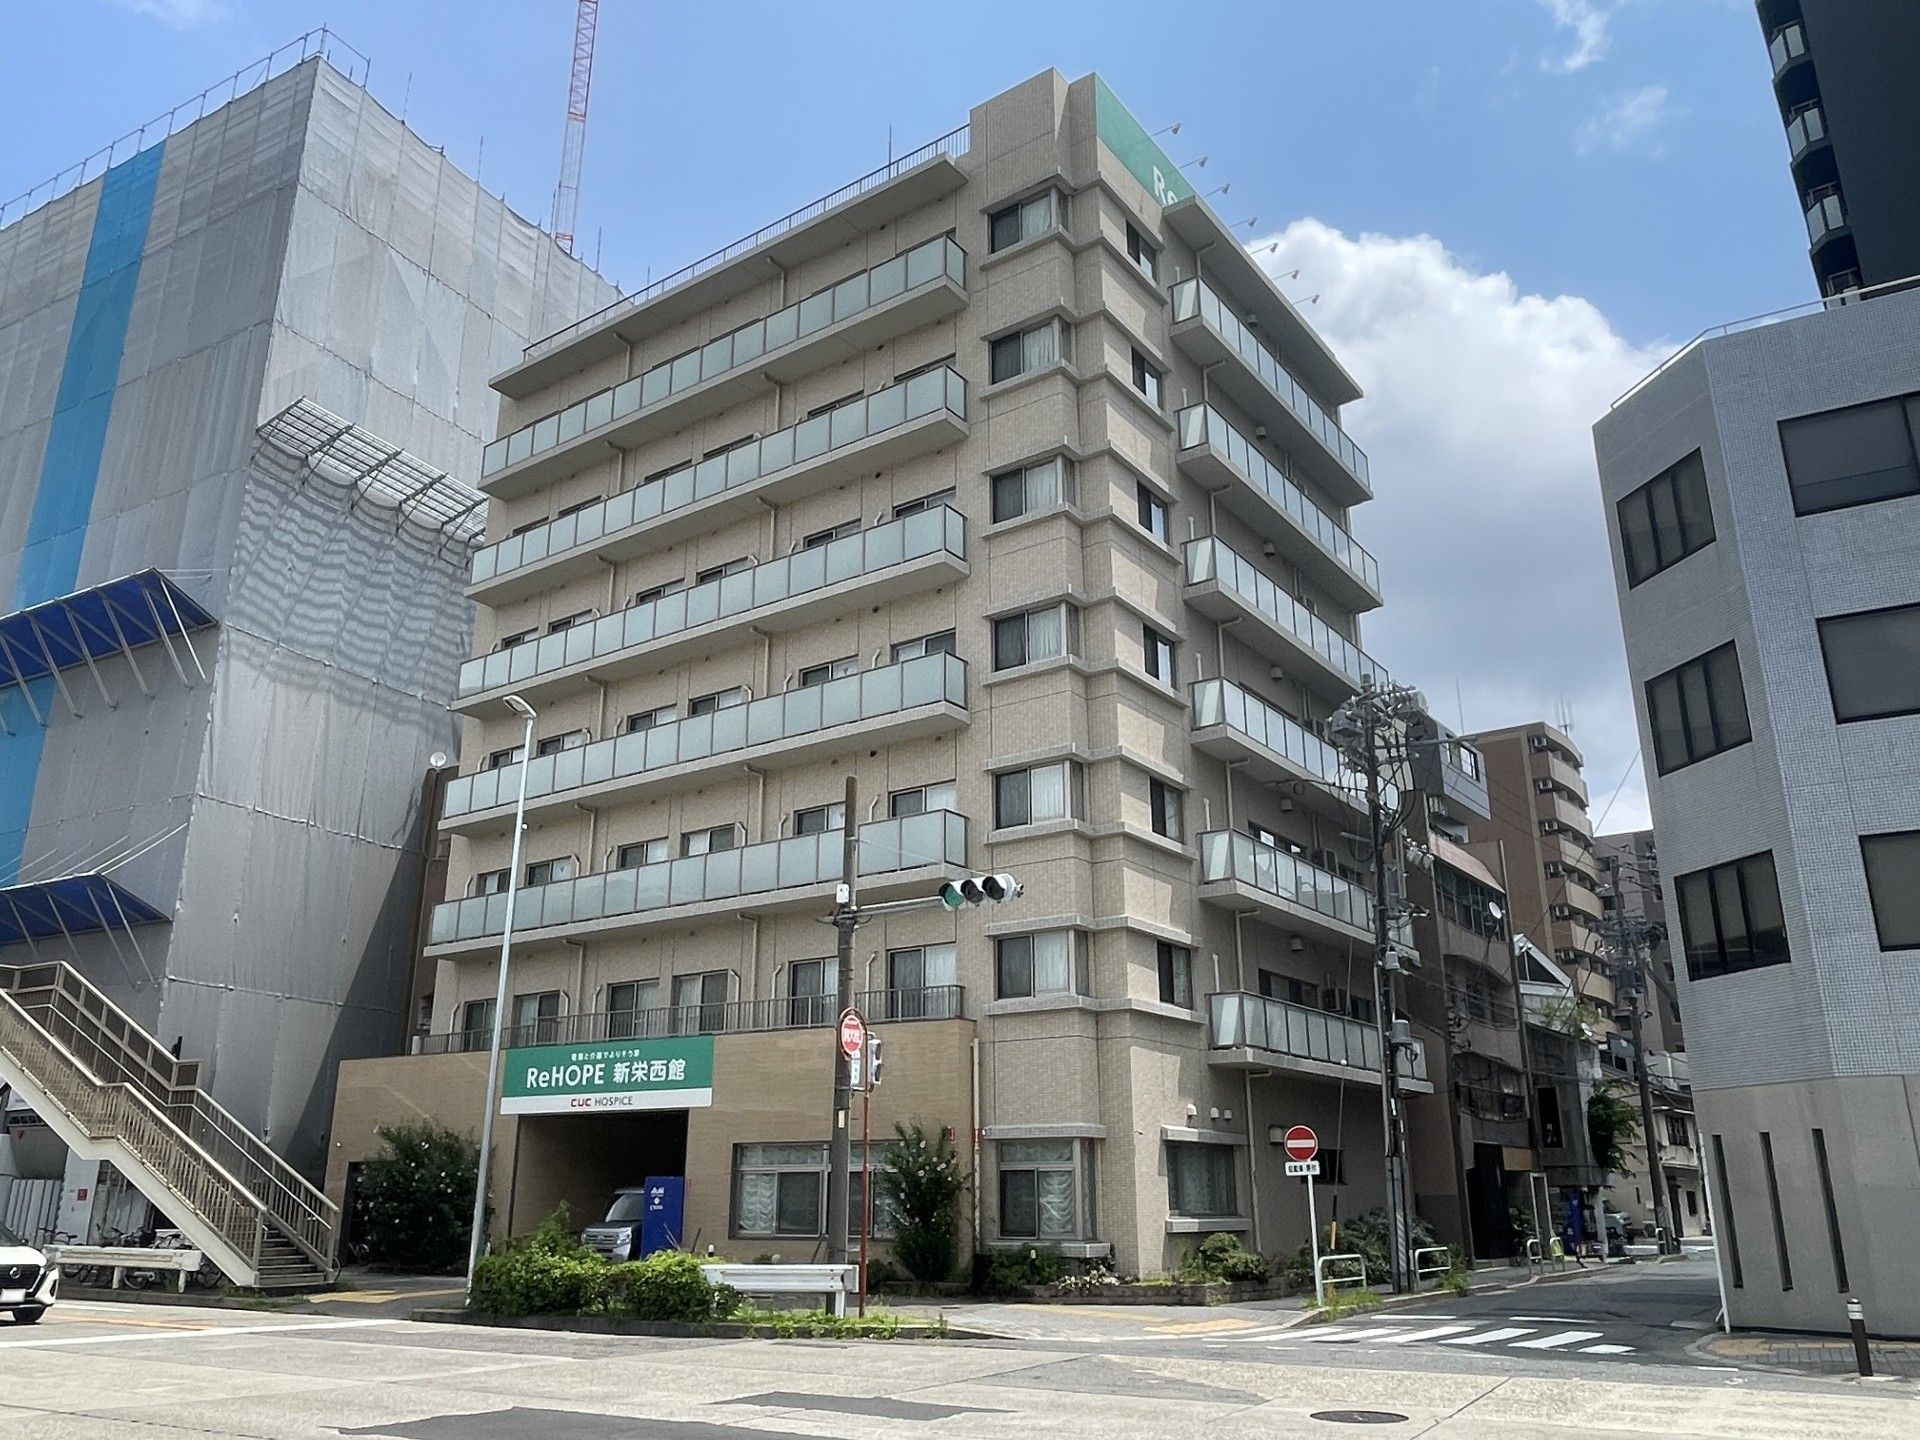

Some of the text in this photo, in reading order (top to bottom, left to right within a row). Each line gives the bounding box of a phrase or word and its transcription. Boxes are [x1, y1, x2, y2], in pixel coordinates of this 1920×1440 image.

[526, 1058, 686, 1089] ReHOPE 新栄西館
[570, 1095, 634, 1108] CUC HOSPICE
